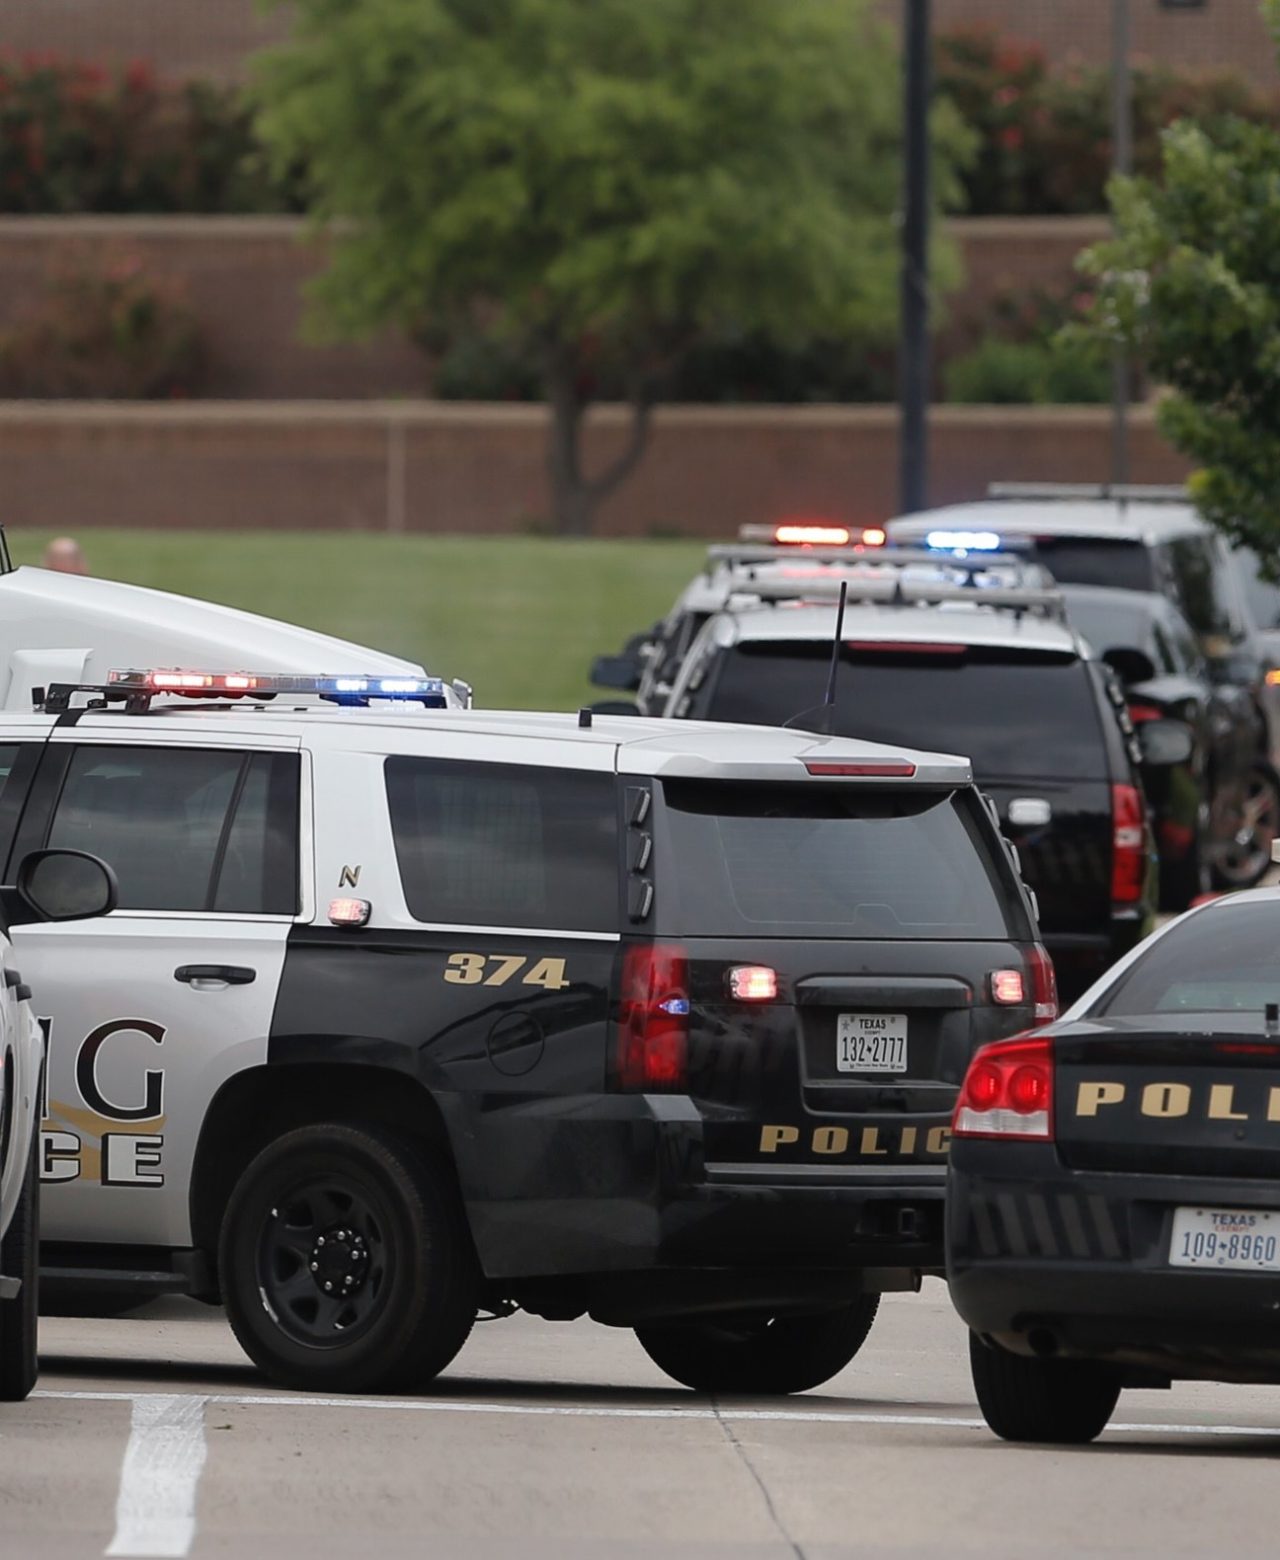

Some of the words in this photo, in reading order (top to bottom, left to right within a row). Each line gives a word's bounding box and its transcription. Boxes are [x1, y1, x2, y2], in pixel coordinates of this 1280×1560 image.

[338, 865, 361, 888] N
[443, 952, 571, 990] 374
[859, 1018, 886, 1030] TEXAS
[1211, 1212, 1257, 1227] TEXAS
